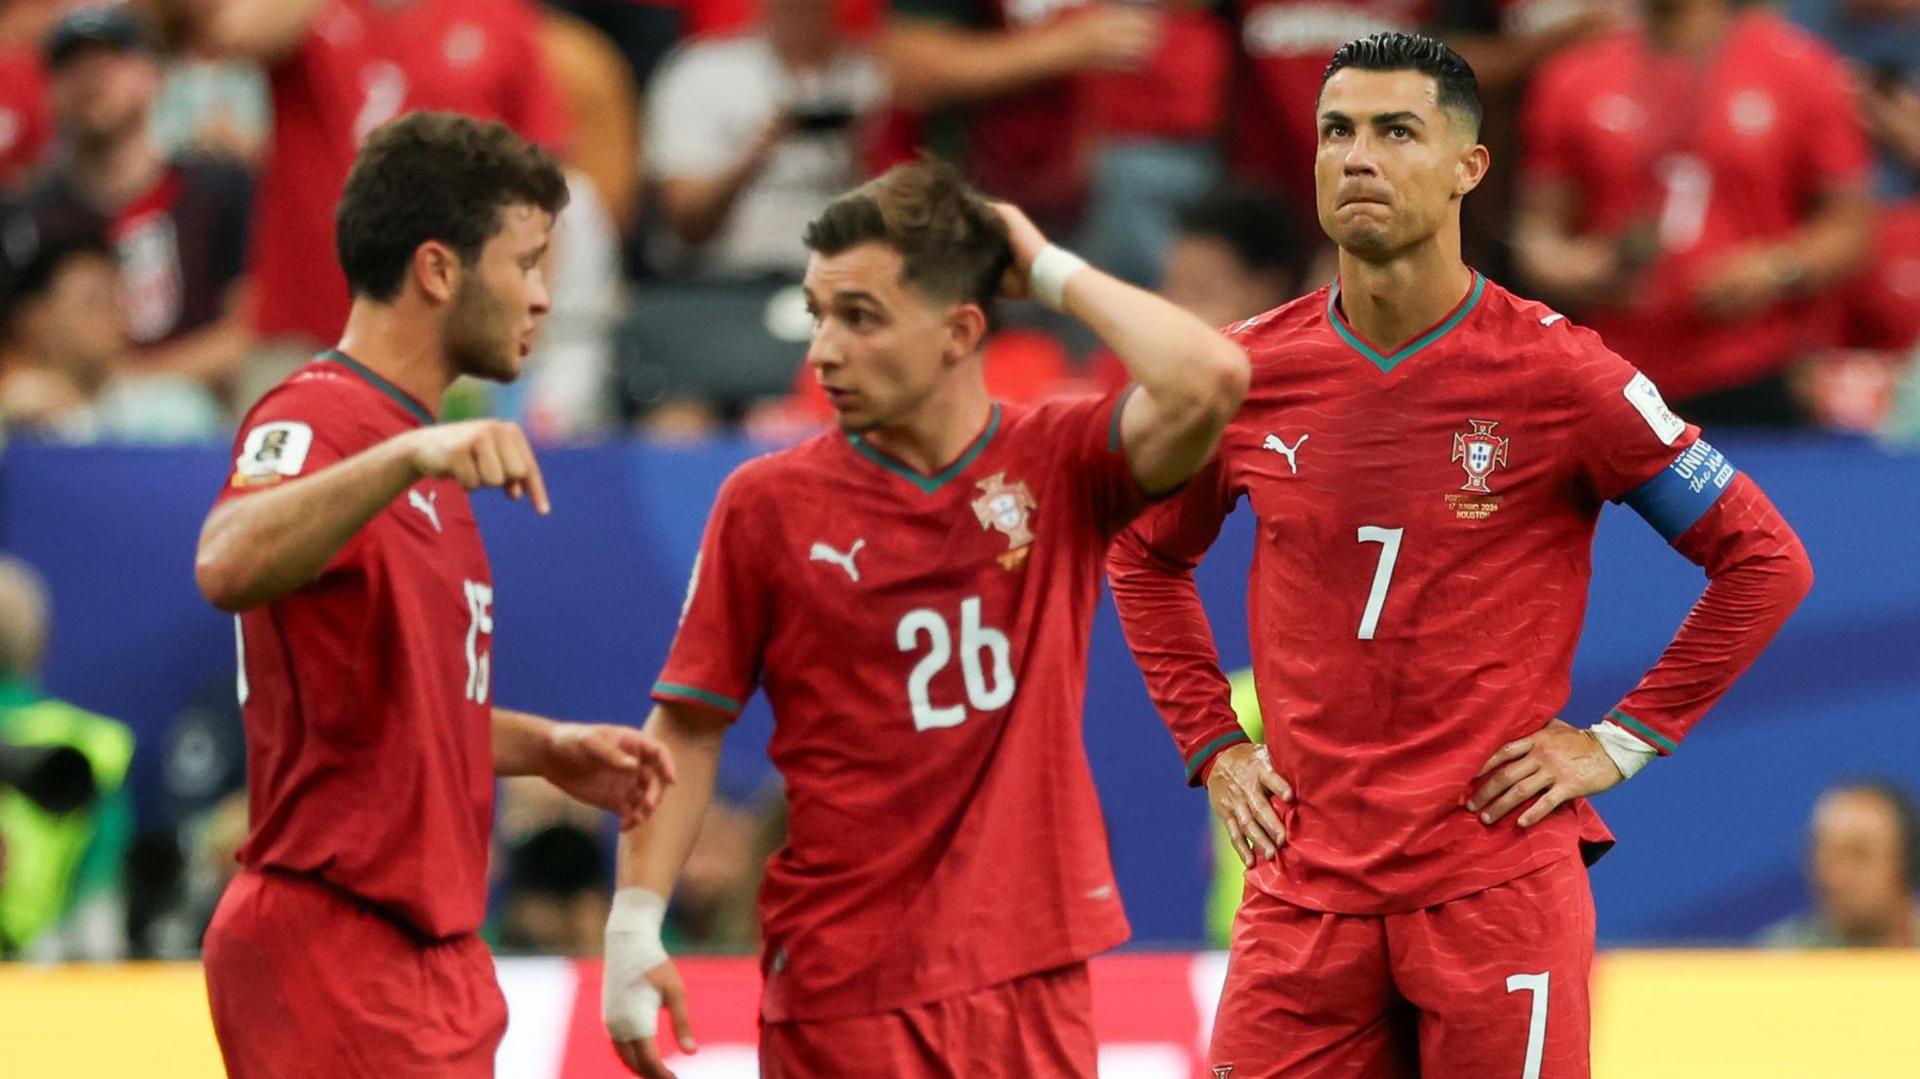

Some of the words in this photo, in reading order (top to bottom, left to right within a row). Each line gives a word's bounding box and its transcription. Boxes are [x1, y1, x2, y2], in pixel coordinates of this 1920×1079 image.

[1456, 510, 1490, 519] HOUSTON
[1688, 471, 1711, 493] the
[1357, 526, 1404, 640] 7
[896, 595, 1016, 732] 26
[1506, 970, 1550, 1079] 7
